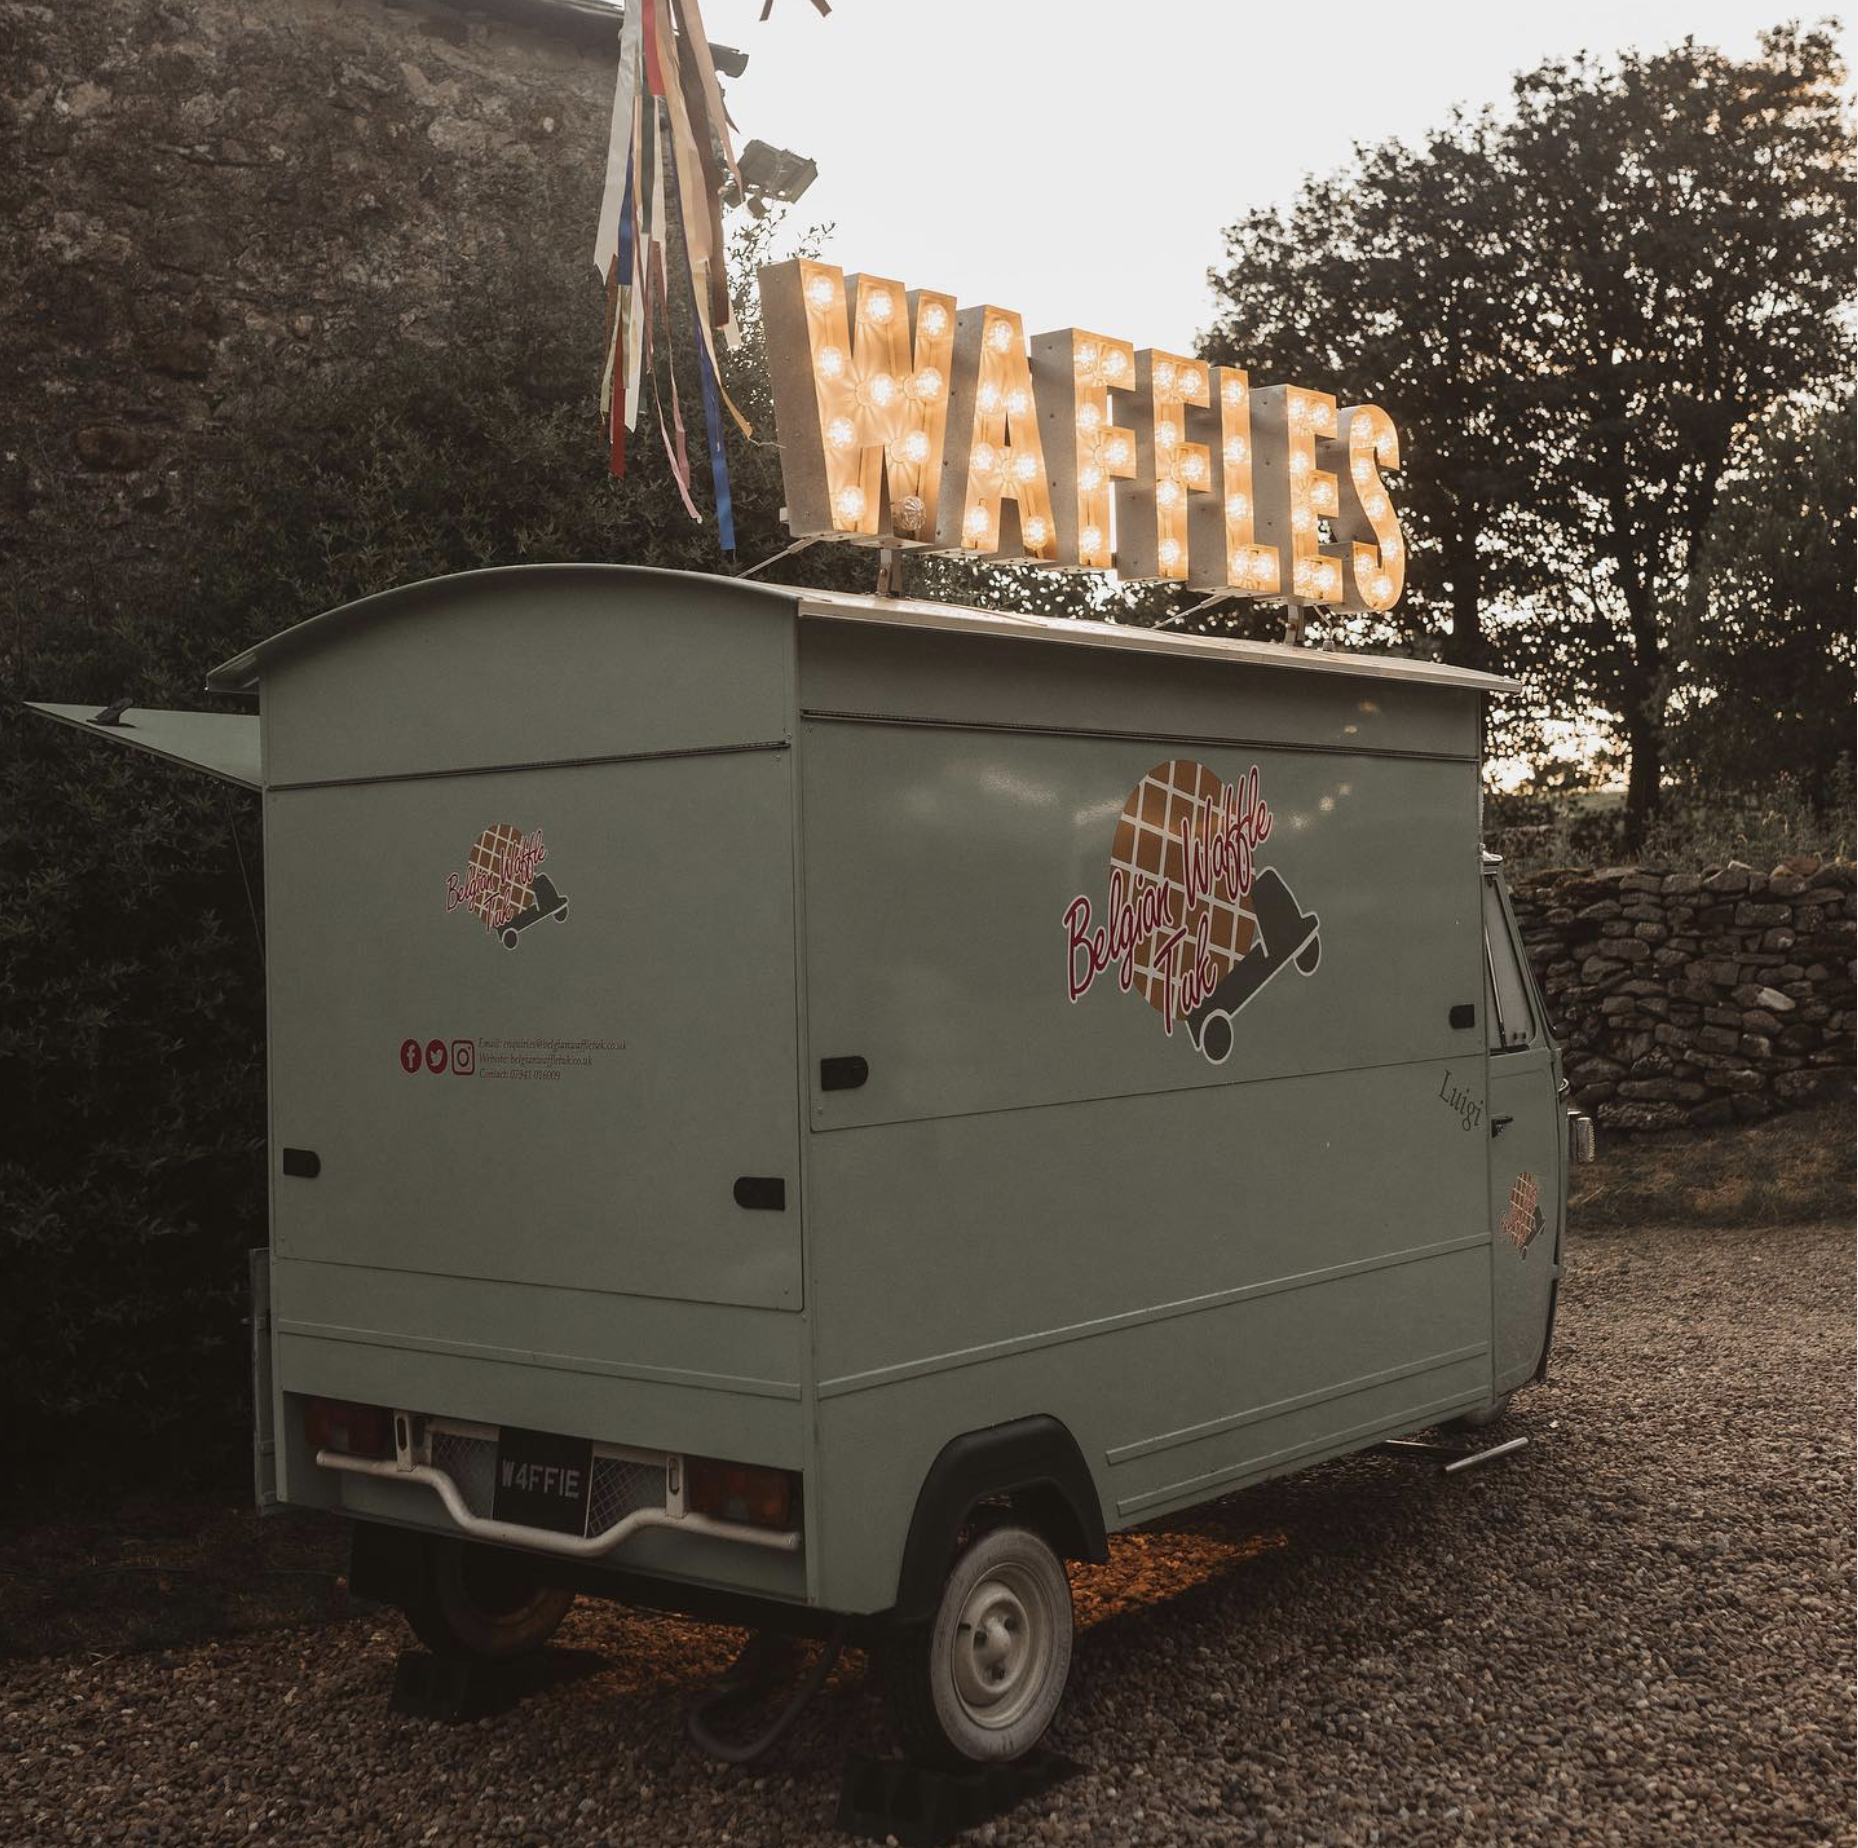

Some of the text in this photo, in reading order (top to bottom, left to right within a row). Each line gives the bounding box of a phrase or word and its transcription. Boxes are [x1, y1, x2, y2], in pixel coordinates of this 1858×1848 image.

[762, 258, 1405, 613] WAFFLES
[446, 828, 548, 913] Belgian Waffle
[1062, 764, 1274, 1005] Belgian Waffle
[1153, 910, 1218, 1037] Tuk
[1438, 1069, 1484, 1132] Luigi
[502, 1459, 581, 1499] W4FFIE
